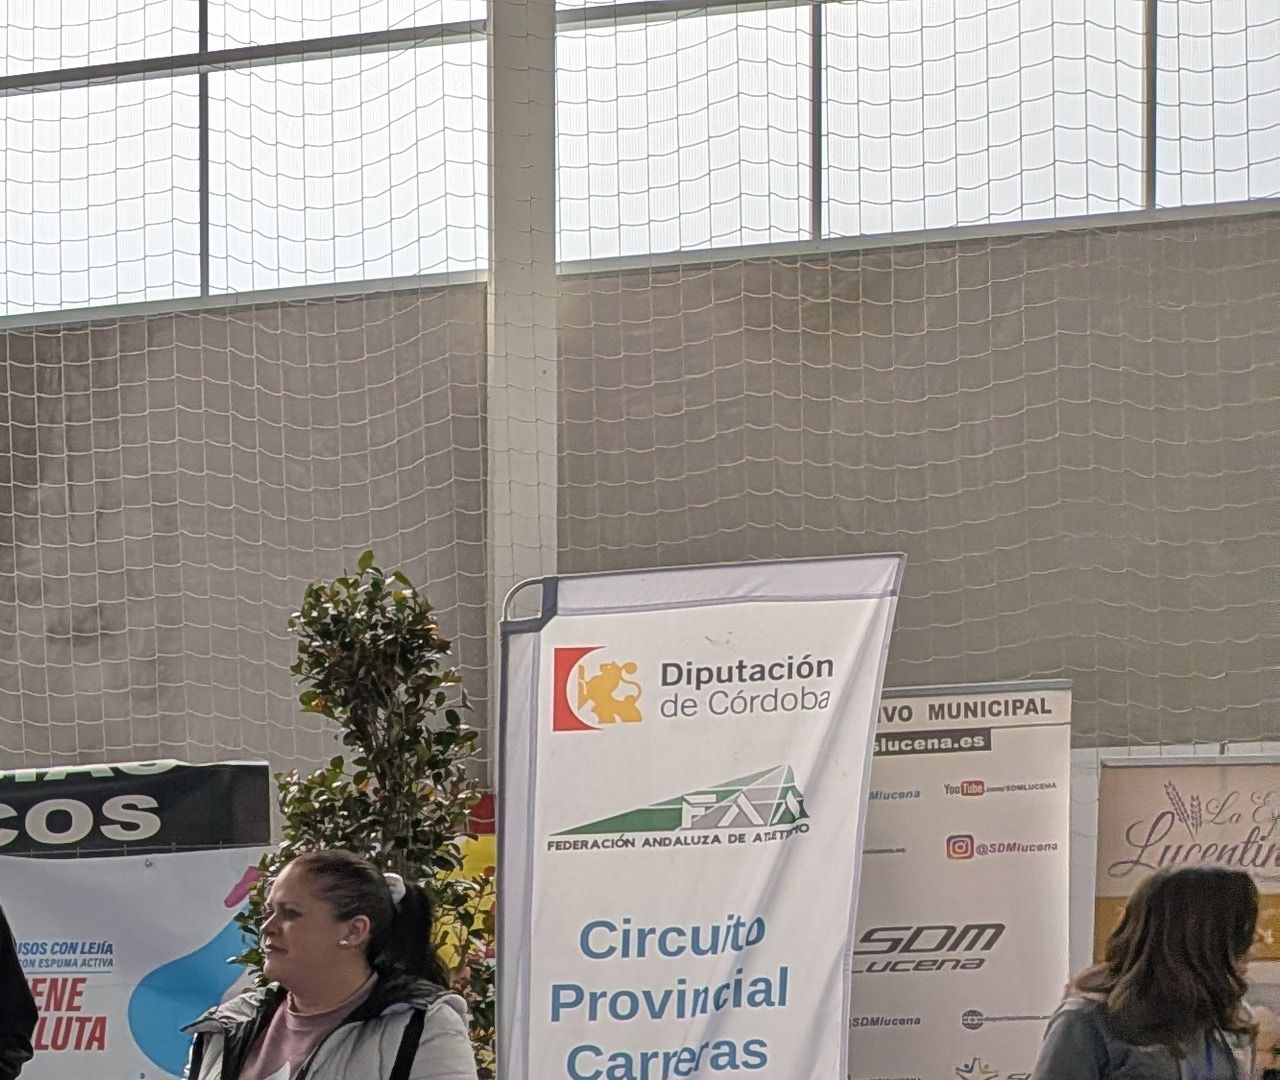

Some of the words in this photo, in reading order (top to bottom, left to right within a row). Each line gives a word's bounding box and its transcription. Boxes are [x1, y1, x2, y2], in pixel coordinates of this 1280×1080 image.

[661, 654, 834, 690] Diputación
[660, 693, 698, 718] de
[708, 687, 831, 716] Córdoba
[928, 698, 1052, 721] MUNICIPAL
[873, 735, 985, 752] slucena.es
[547, 834, 635, 851] FEDERACIÓN
[642, 835, 721, 848] ANDALUZA
[728, 833, 746, 844] DE
[51, 942, 78, 955] CON
[80, 940, 113, 955] LEJÍA
[579, 913, 766, 960] Circuito
[853, 923, 1006, 955] SDM
[40, 959, 78, 968] ESPUMA
[80, 958, 113, 968] ACTIVA
[28, 978, 87, 1012] ENE
[550, 965, 789, 1023] Provincial
[34, 1016, 107, 1050] LUTA
[851, 1017, 921, 1029] SDMlucena
